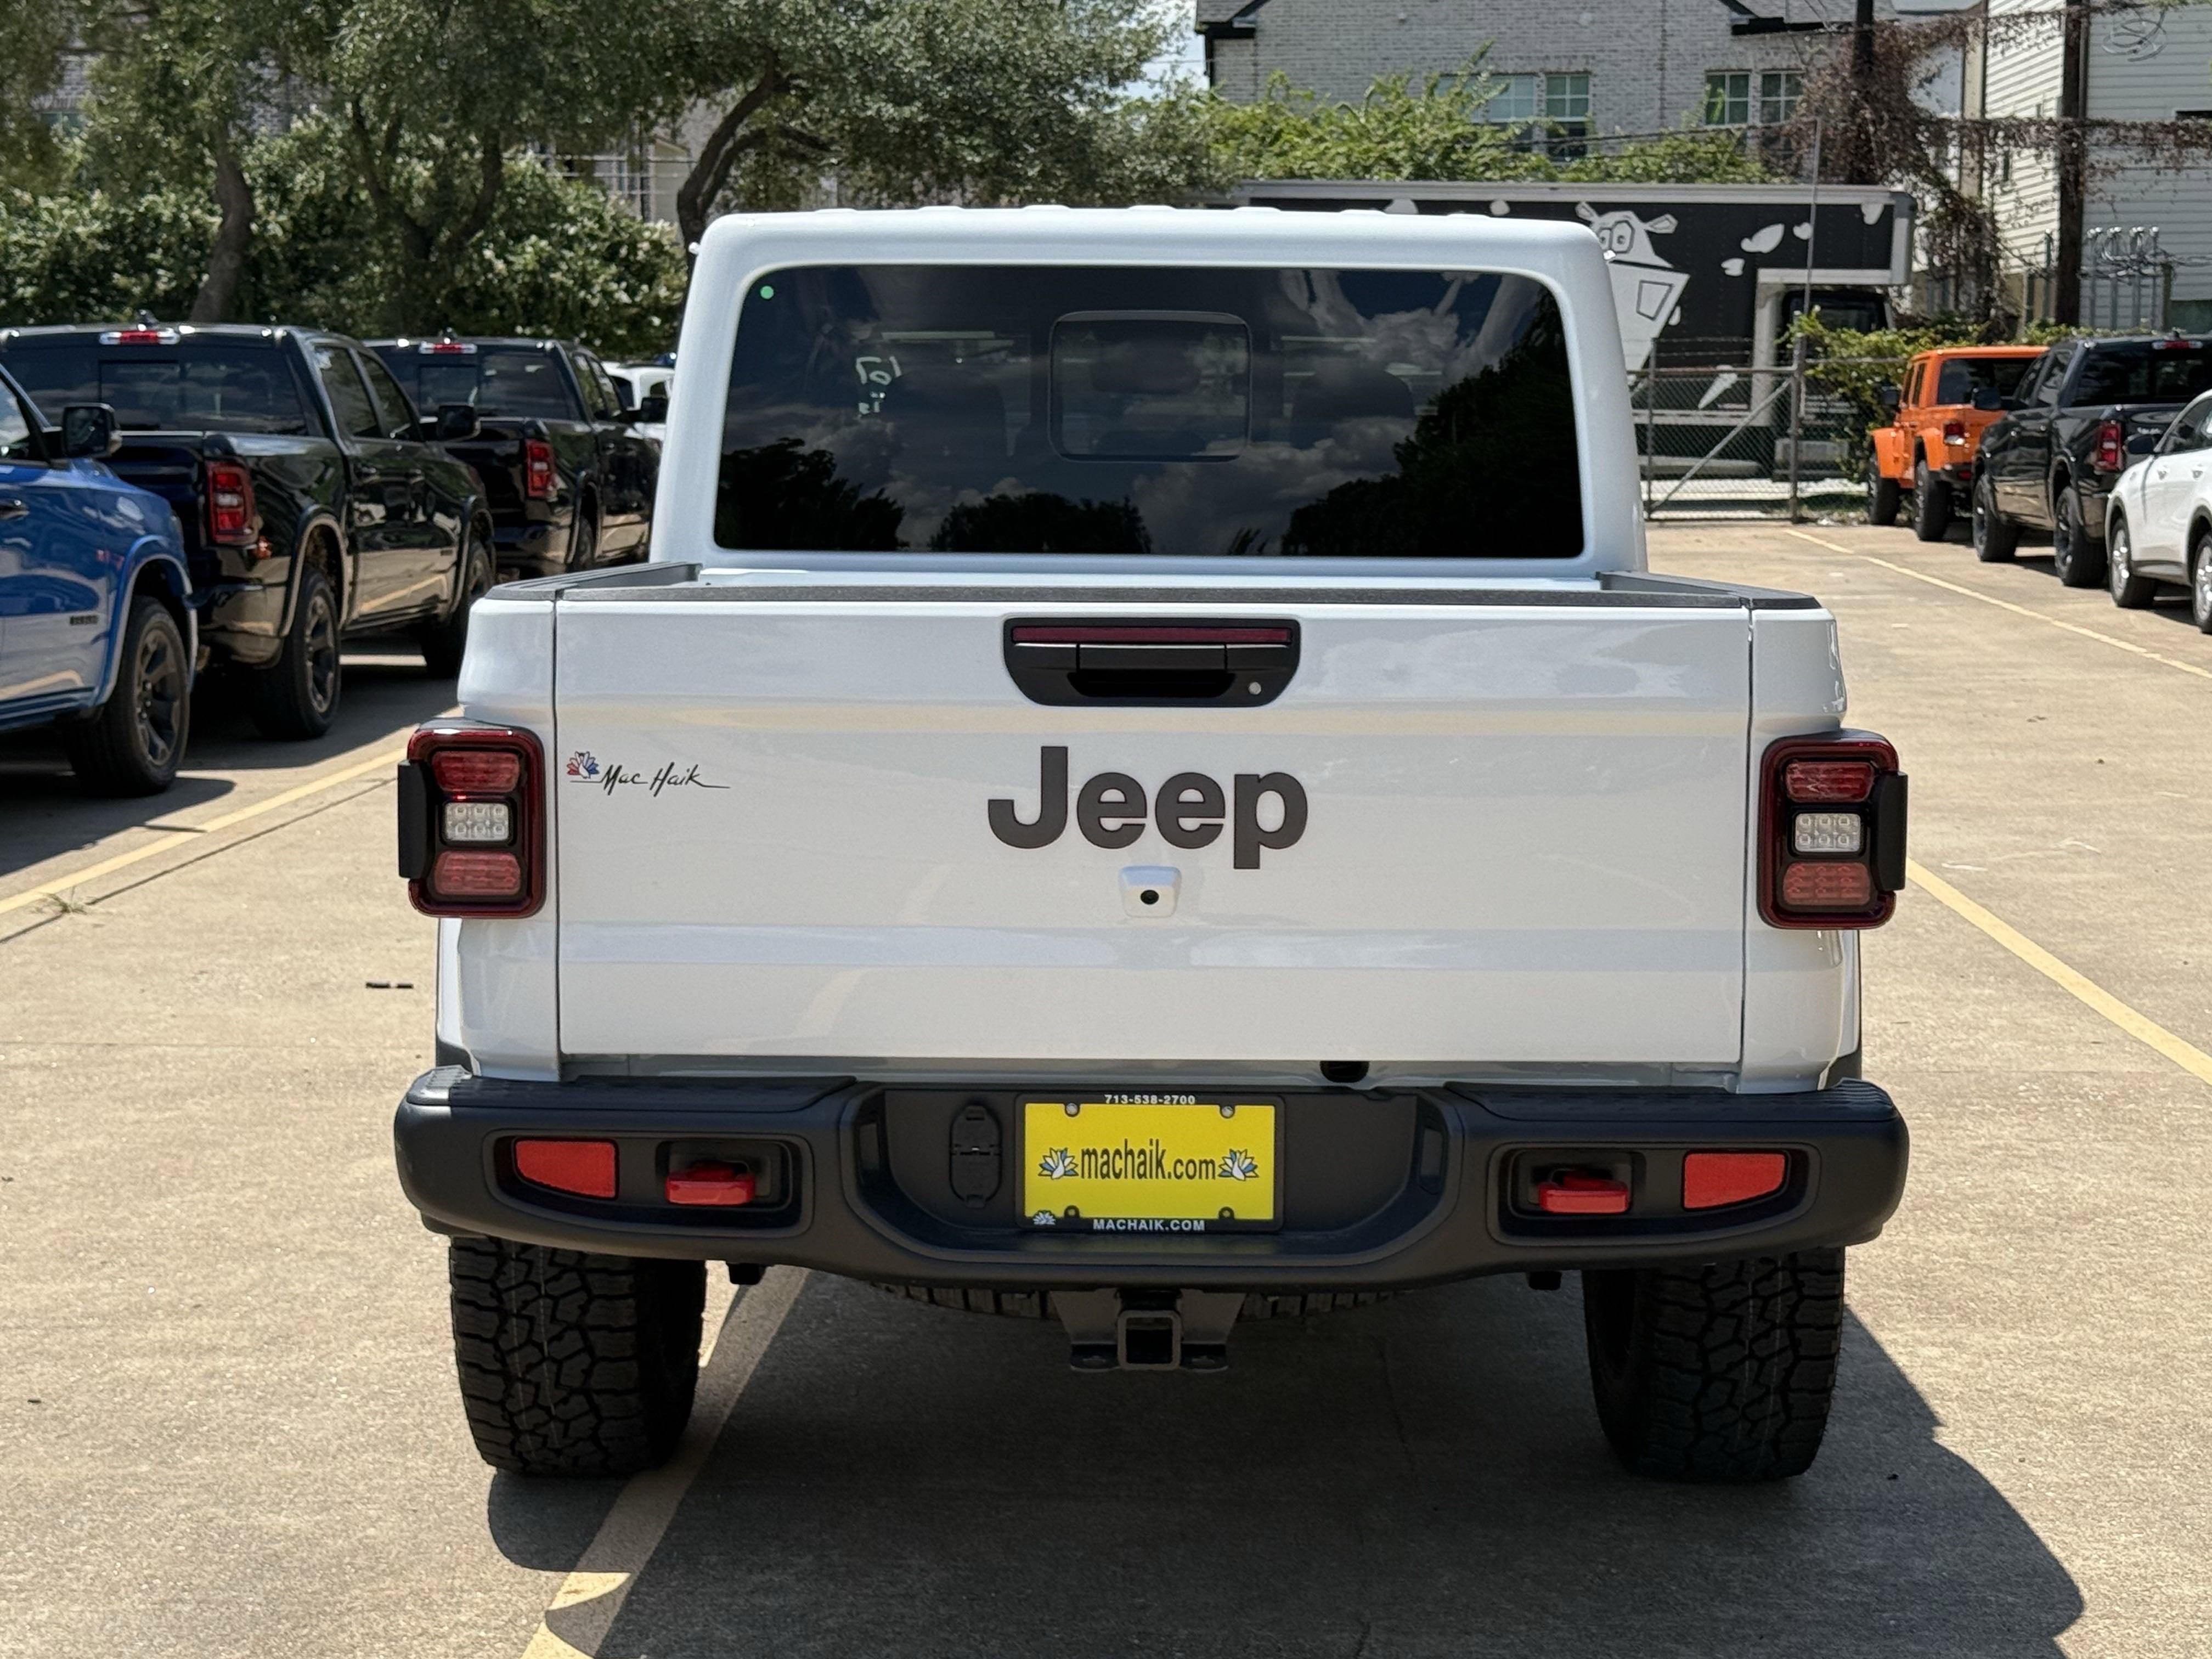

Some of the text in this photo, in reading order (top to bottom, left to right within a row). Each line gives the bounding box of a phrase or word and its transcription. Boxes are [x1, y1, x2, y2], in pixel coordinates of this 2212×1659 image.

[601, 761, 730, 797] Mac Haik
[988, 746, 1308, 869] Jeep
[1081, 1138, 1216, 1180] machaik.com
[1093, 1220, 1205, 1231] MACHAIK.COM
